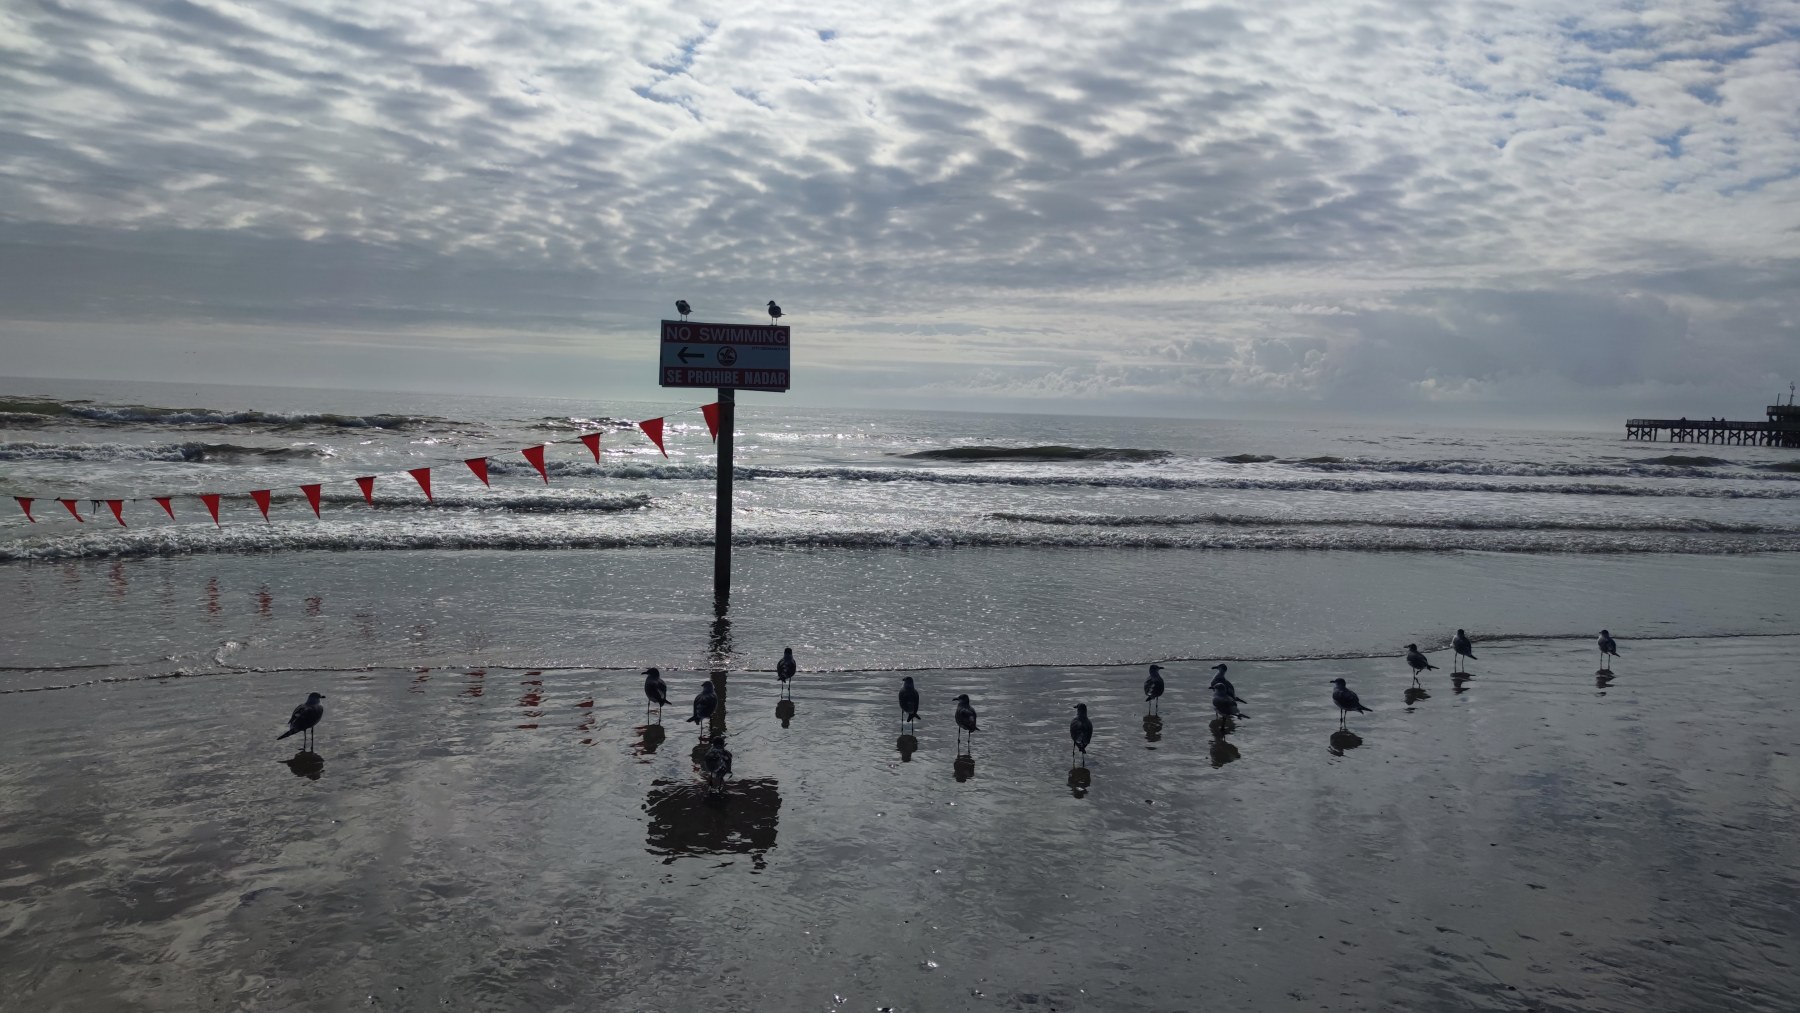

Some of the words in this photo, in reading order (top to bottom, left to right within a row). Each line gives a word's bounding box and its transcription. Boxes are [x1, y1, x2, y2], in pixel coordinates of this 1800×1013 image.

[666, 326, 691, 341] NO
[699, 327, 786, 344] SWIMMING
[666, 370, 682, 383] SE
[688, 370, 739, 384] PROHIBE
[745, 371, 786, 385] NADAR
